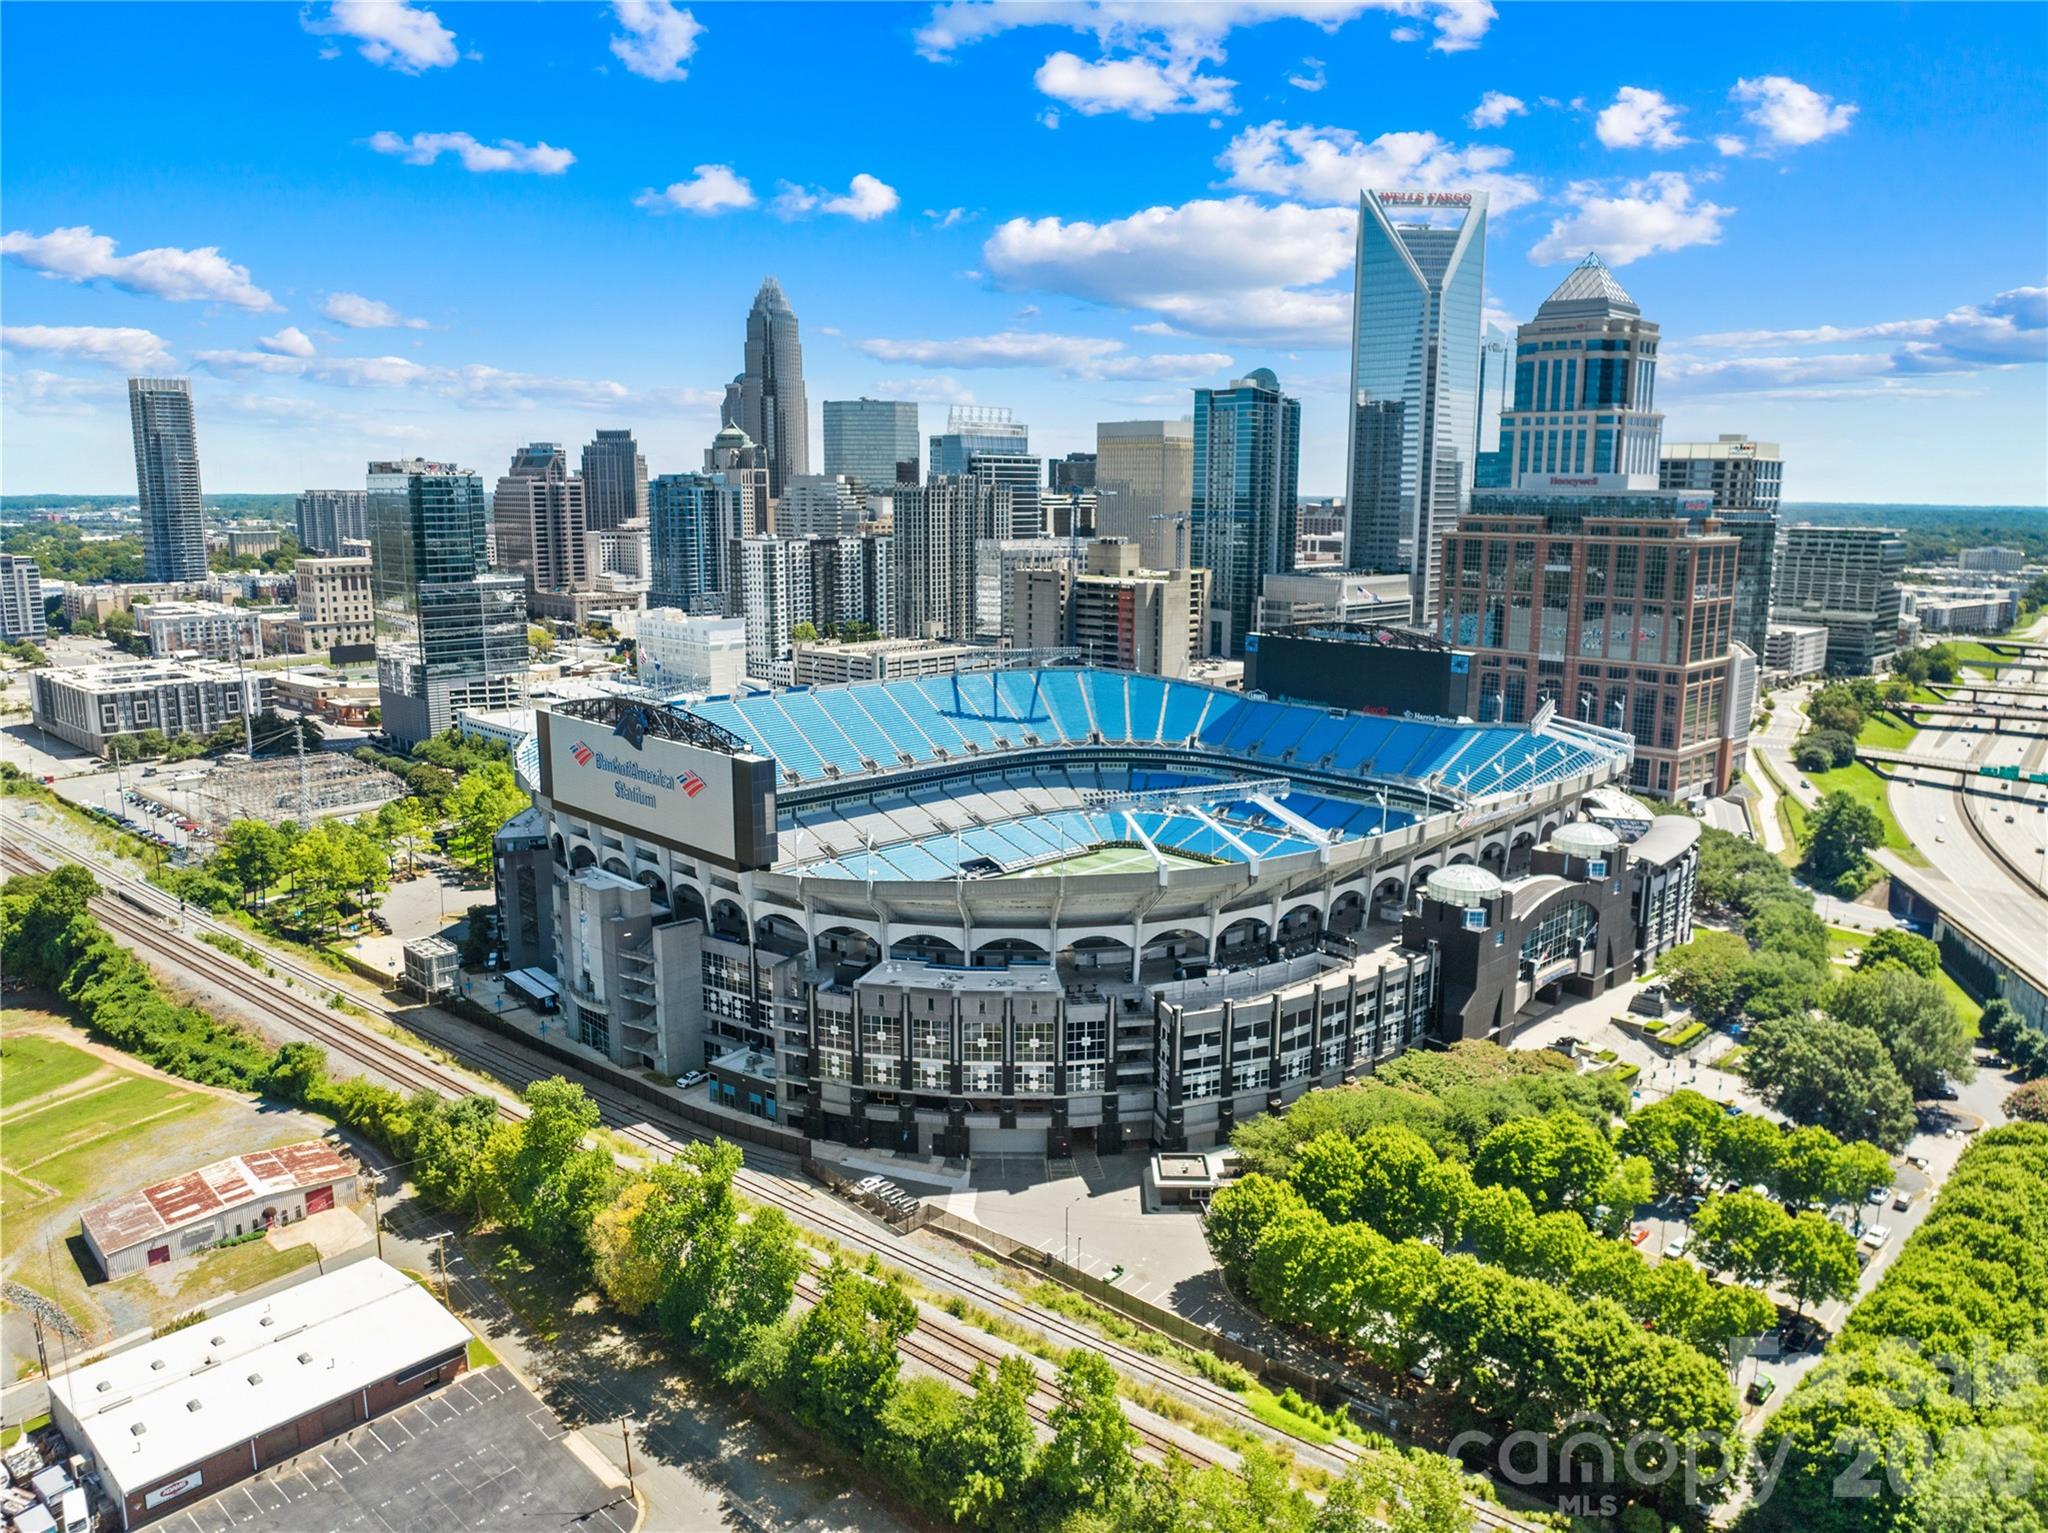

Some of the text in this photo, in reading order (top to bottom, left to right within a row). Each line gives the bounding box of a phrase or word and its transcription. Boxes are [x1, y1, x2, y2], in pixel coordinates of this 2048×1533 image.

[1379, 192, 1472, 205] WELLS FARGO
[1550, 476, 1599, 487] Honeywell
[1414, 712, 1456, 724] Harris Teeter
[614, 780, 656, 808] Stadium
